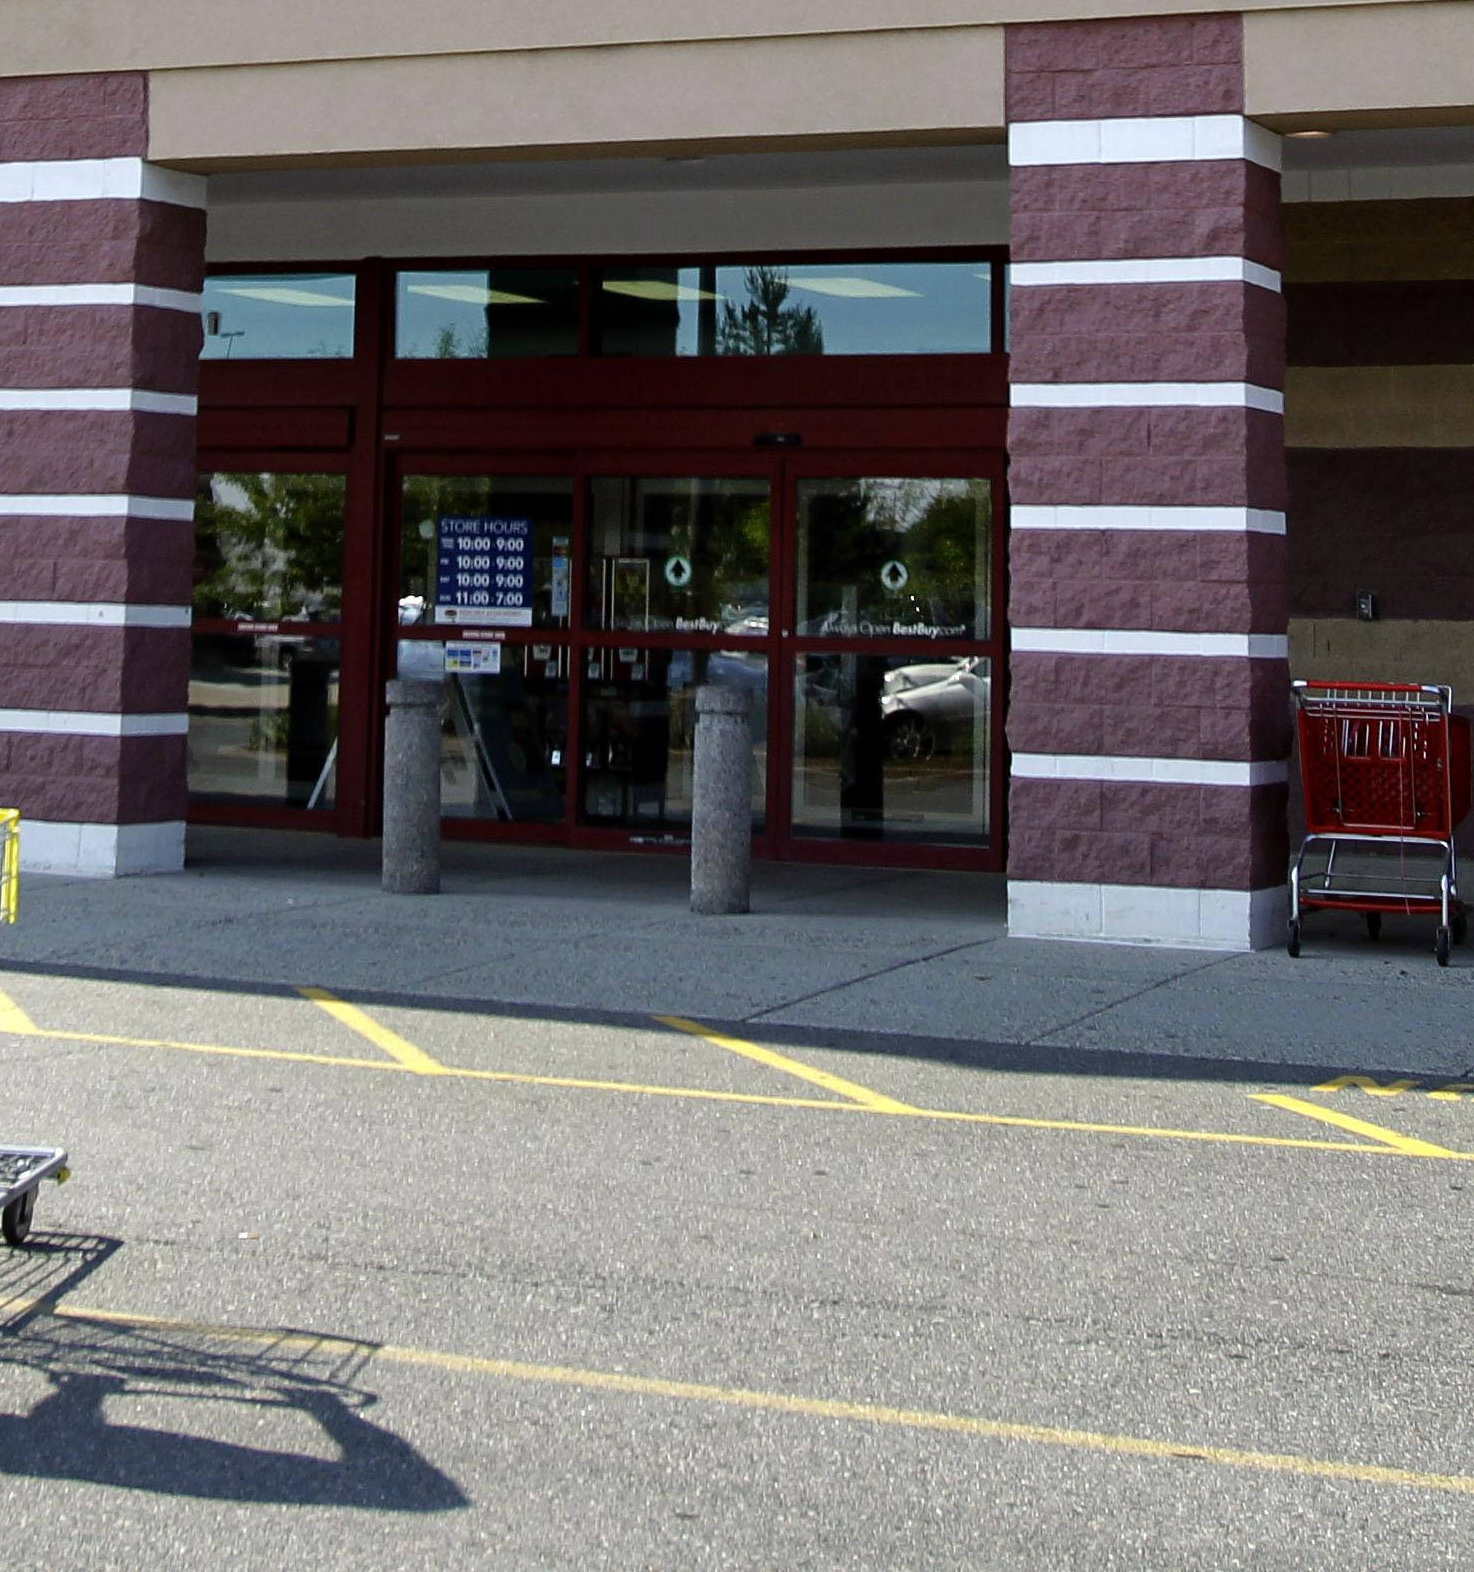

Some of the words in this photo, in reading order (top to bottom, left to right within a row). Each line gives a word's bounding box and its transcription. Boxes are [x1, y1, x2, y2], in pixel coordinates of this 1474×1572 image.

[440, 519, 480, 534] STORE
[483, 520, 528, 535] HOURS
[457, 537, 491, 551] 10:00
[496, 537, 524, 552] 9:00
[456, 556, 490, 570] 10:00
[495, 556, 524, 570] 9:00
[456, 574, 490, 588] 10:00
[495, 574, 524, 588] 9:00
[455, 591, 489, 605] 11:00
[496, 592, 523, 606] 7:00
